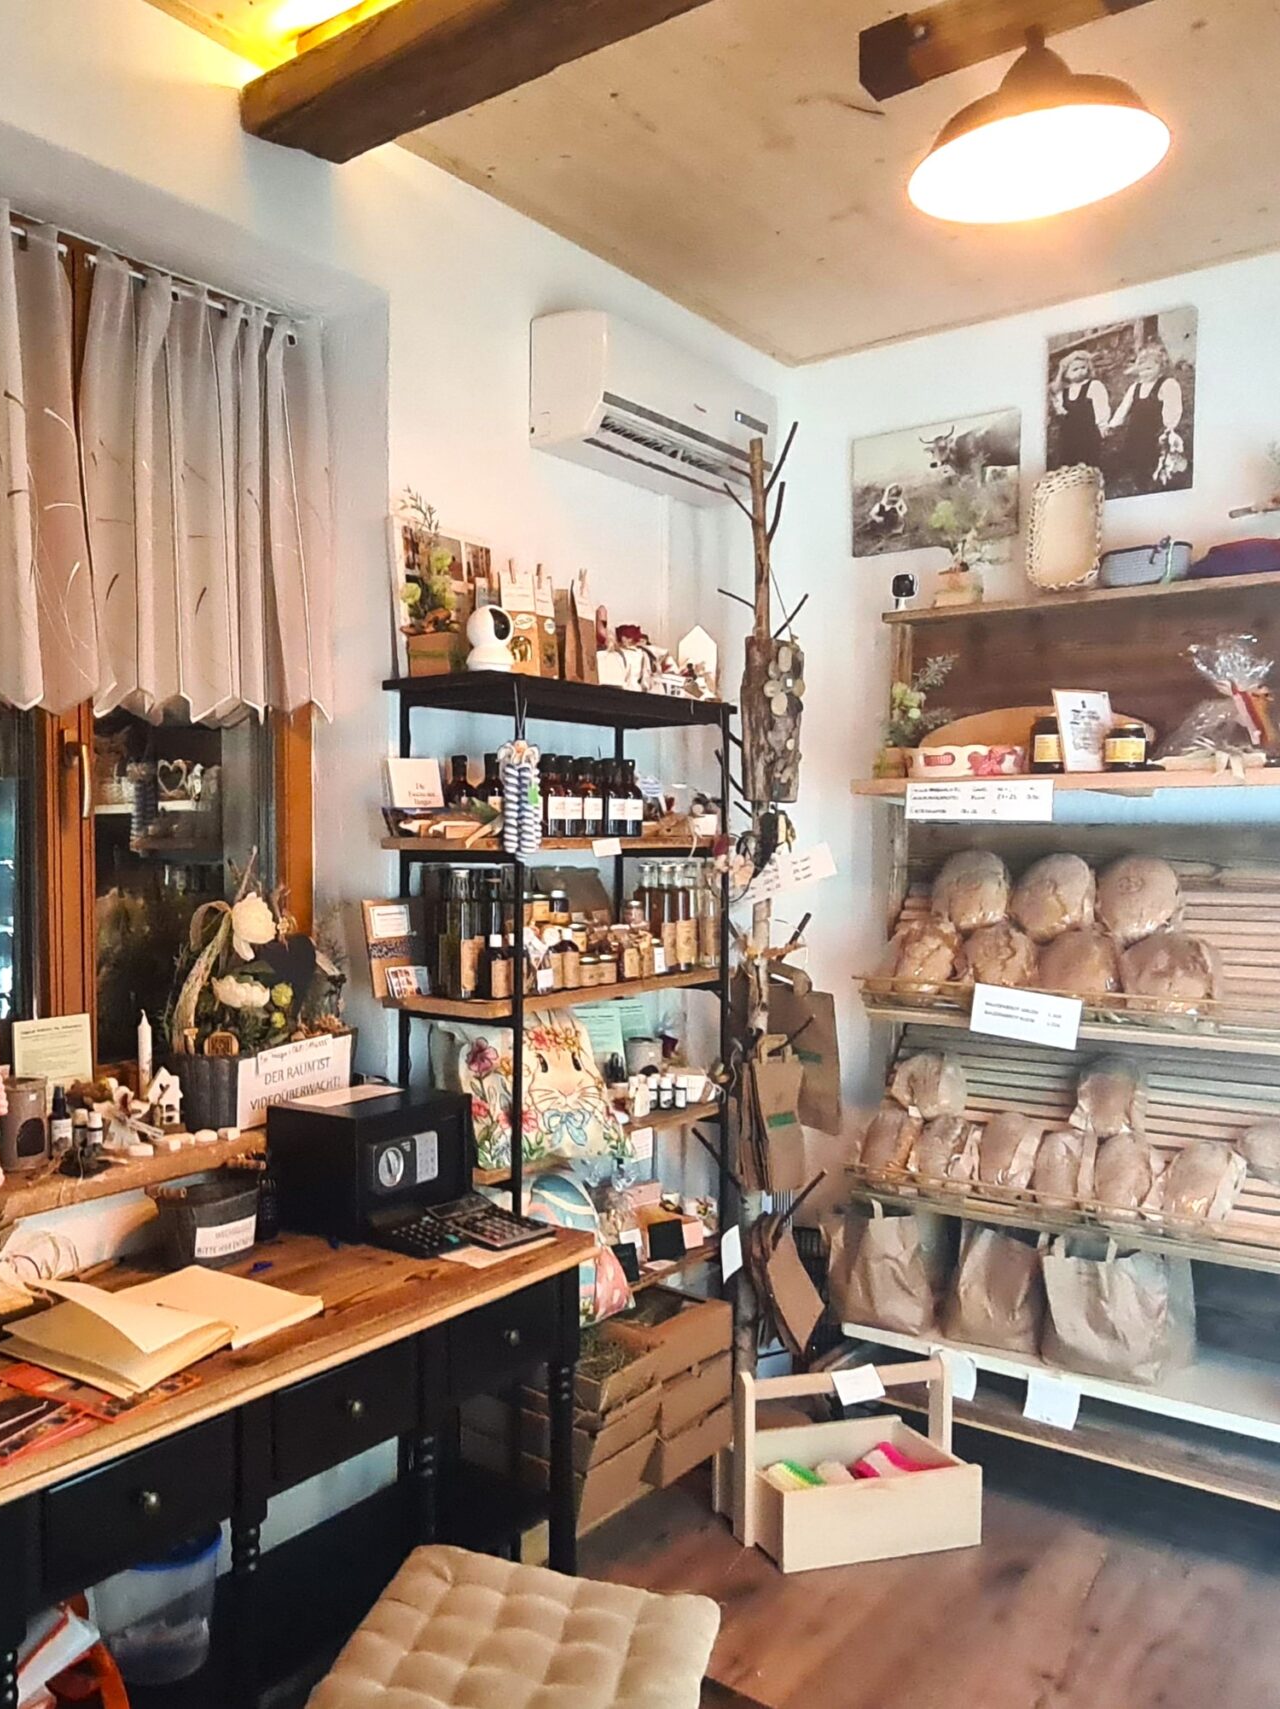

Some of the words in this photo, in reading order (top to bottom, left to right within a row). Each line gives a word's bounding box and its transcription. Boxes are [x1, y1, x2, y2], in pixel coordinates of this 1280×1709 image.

[264, 1069, 285, 1086] DER
[286, 1060, 316, 1079] RAUM
[316, 1056, 332, 1070] IST
